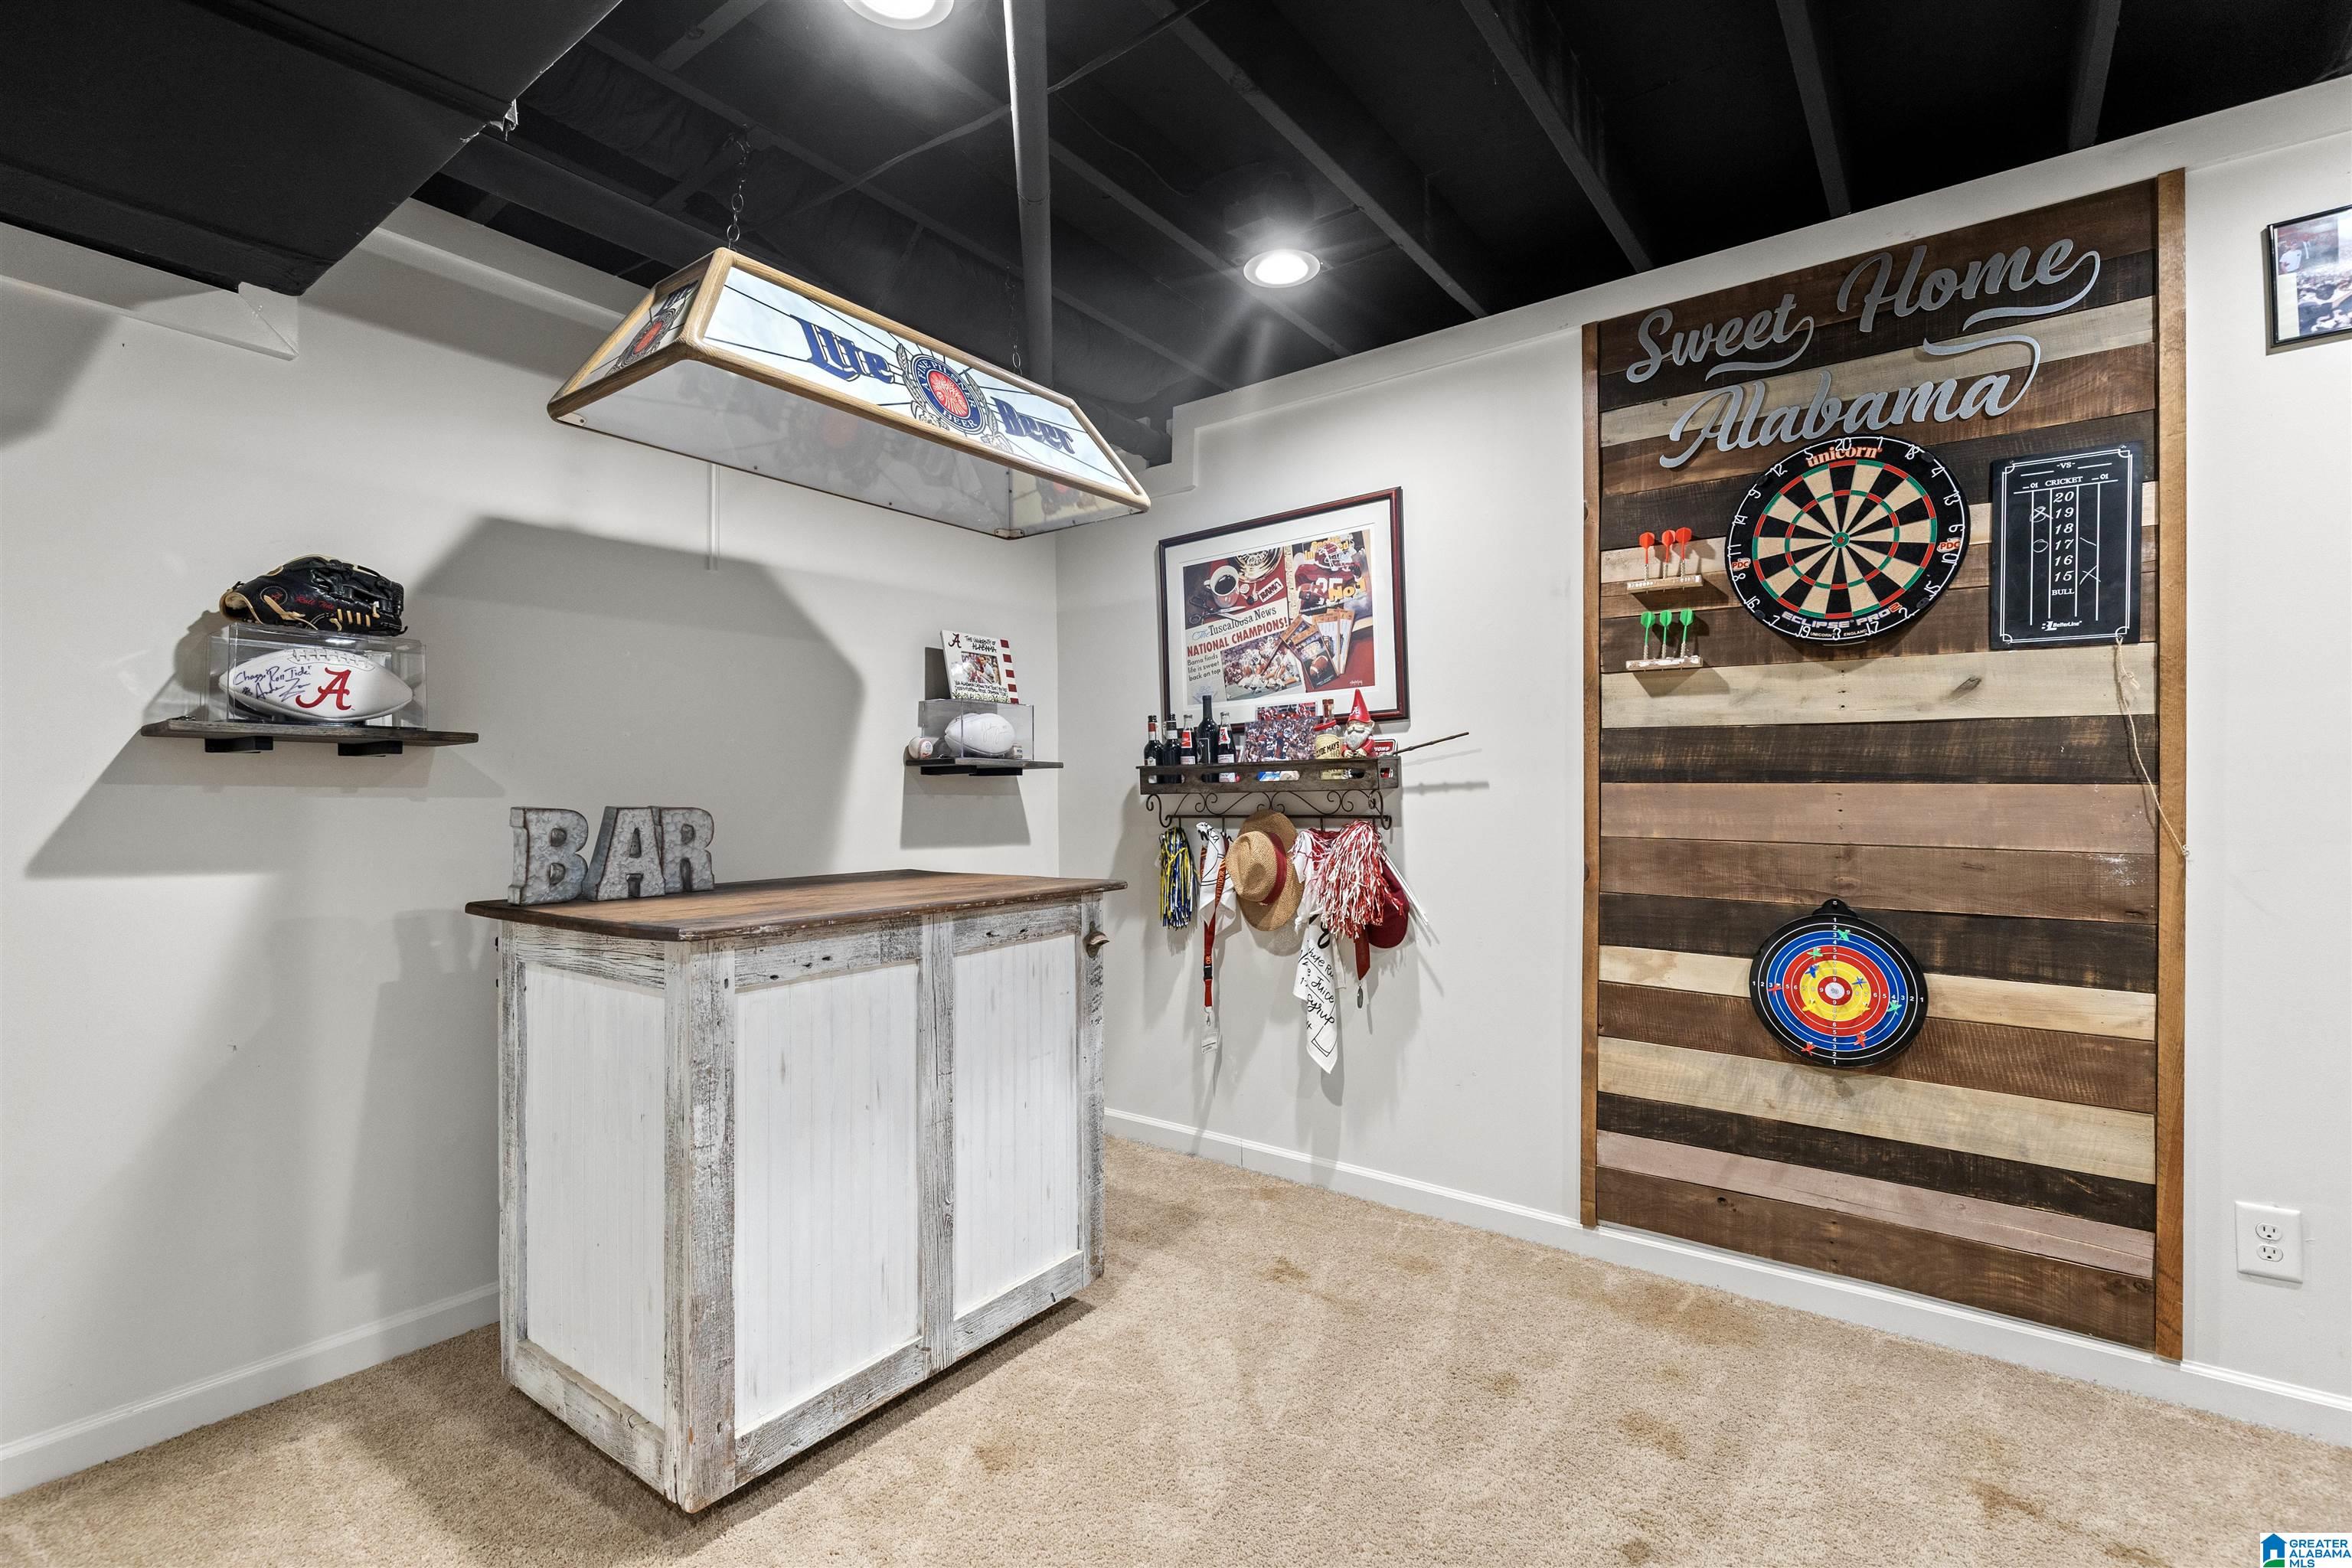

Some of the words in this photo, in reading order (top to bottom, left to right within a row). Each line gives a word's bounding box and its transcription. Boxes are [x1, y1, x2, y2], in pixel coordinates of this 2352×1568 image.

[1626, 294, 1815, 383] Sweet
[1838, 238, 2101, 333] Home
[789, 314, 894, 384] Lite
[990, 396, 1075, 454] Beer
[918, 360, 931, 380] FINE
[931, 361, 977, 408] PILSNER
[1658, 334, 2041, 469] Alabama
[942, 410, 978, 428] BEER
[1835, 437, 1851, 451] 20
[1804, 449, 1814, 460] 5
[1805, 443, 1879, 468] unicorn
[1770, 463, 1788, 477] 12
[2045, 476, 2083, 487] CRICKET
[2053, 491, 2074, 503] 20
[2054, 507, 2074, 519] 19
[2054, 523, 2074, 534] 18
[1939, 540, 1962, 550] PDC
[2054, 539, 2074, 550] 17
[1732, 560, 1750, 569] PDC
[2054, 554, 2073, 567] 16
[2054, 570, 2075, 583] 15
[1208, 616, 1253, 635] Tuscaloosa
[1254, 606, 1277, 622] News
[1782, 611, 1851, 629] ECLIPSE
[1187, 637, 1229, 657] NATIONAL
[1232, 617, 1288, 644] CHAMPIONS!
[1795, 626, 1811, 638] 19
[1844, 629, 1867, 637] ENGLAND
[948, 632, 962, 648] A
[1204, 654, 1218, 662] finds
[1203, 661, 1220, 670] sweet
[1188, 672, 1203, 681] back
[1211, 668, 1221, 676] top
[296, 667, 352, 711] A
[508, 806, 714, 906] BAR
